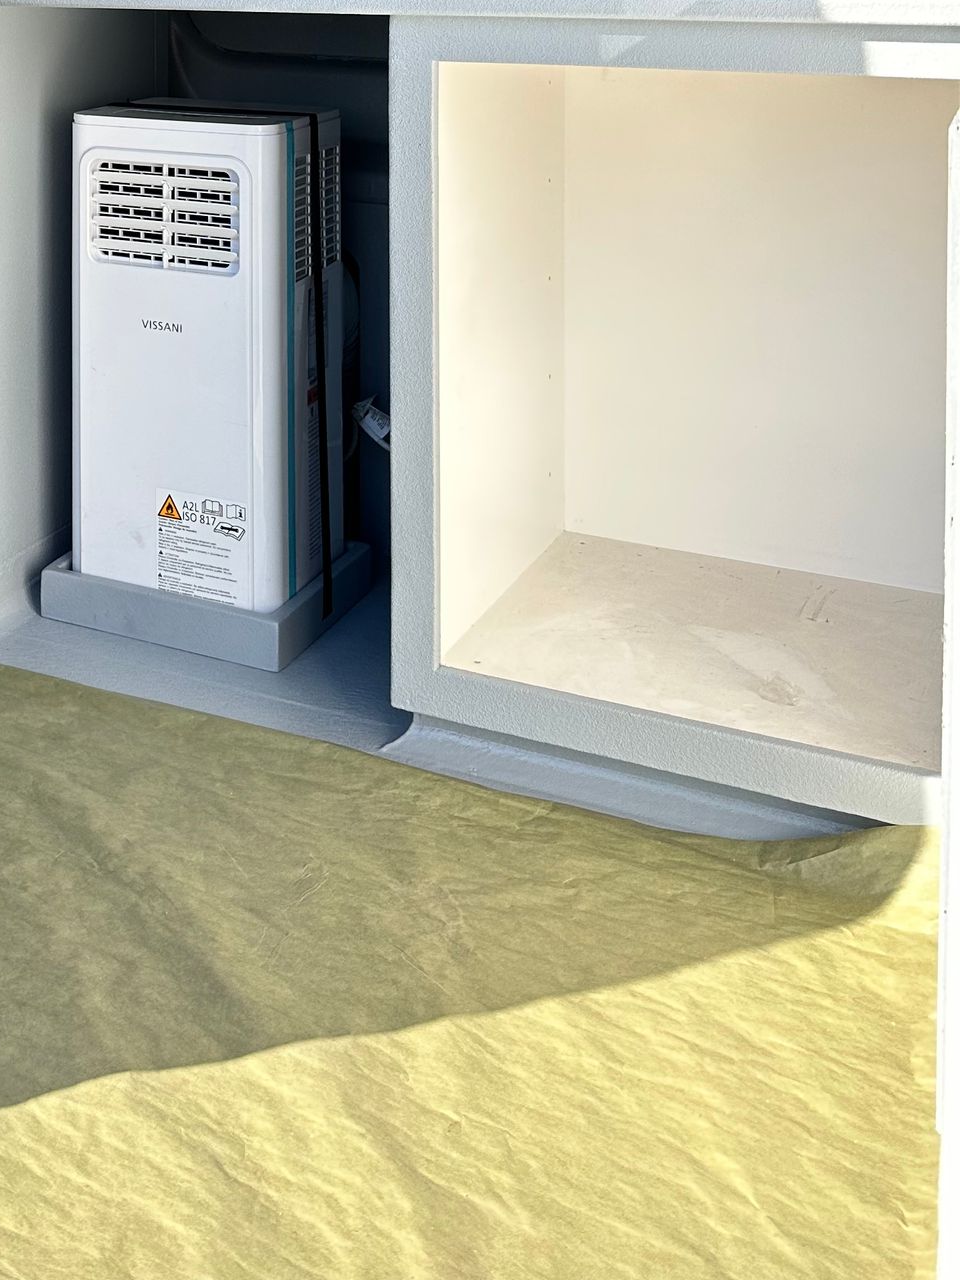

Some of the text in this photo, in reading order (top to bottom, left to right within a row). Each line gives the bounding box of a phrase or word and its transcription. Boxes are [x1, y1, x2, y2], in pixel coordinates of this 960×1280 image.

[141, 319, 183, 333] VISSANI
[182, 501, 199, 513] A2L
[182, 511, 197, 523] ISO
[199, 515, 216, 526] 817
